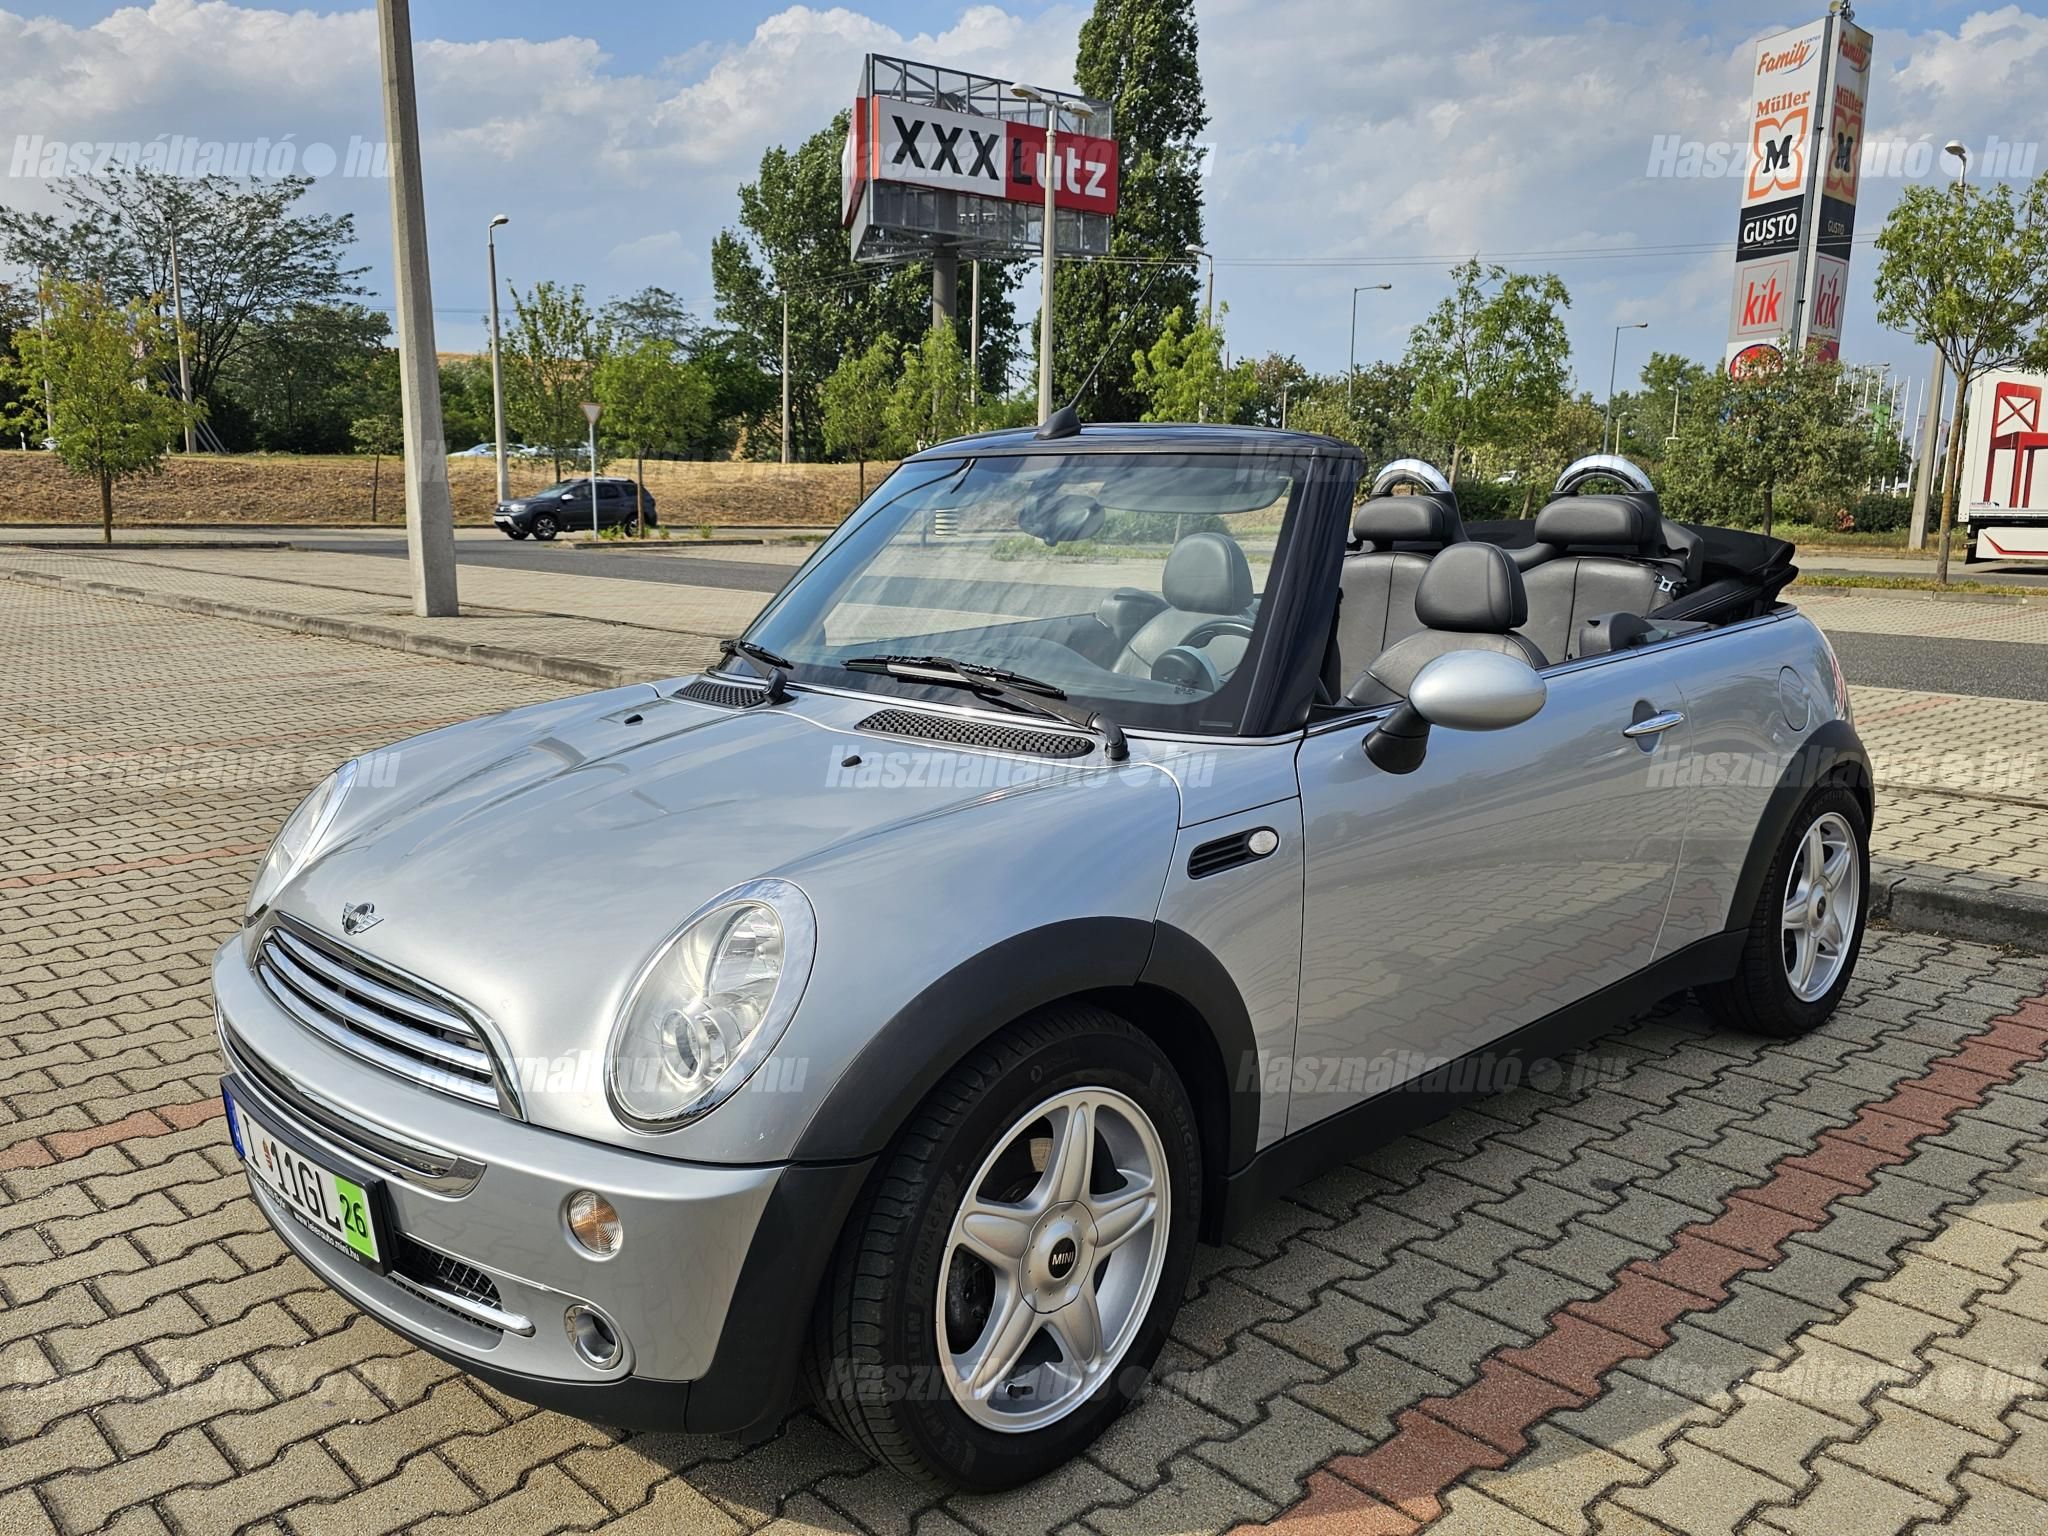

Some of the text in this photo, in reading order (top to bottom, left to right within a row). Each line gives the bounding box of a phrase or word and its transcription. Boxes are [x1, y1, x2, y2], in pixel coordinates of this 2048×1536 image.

[1757, 38, 1811, 76] Family
[1756, 91, 1811, 118] Müller
[1835, 84, 1863, 115] Müller
[1762, 134, 1793, 174] M
[1743, 213, 1798, 244] GUSTO
[1827, 219, 1845, 236] GUSTO
[339, 1193, 369, 1239] 26
[1052, 1251, 1075, 1266] MINI
